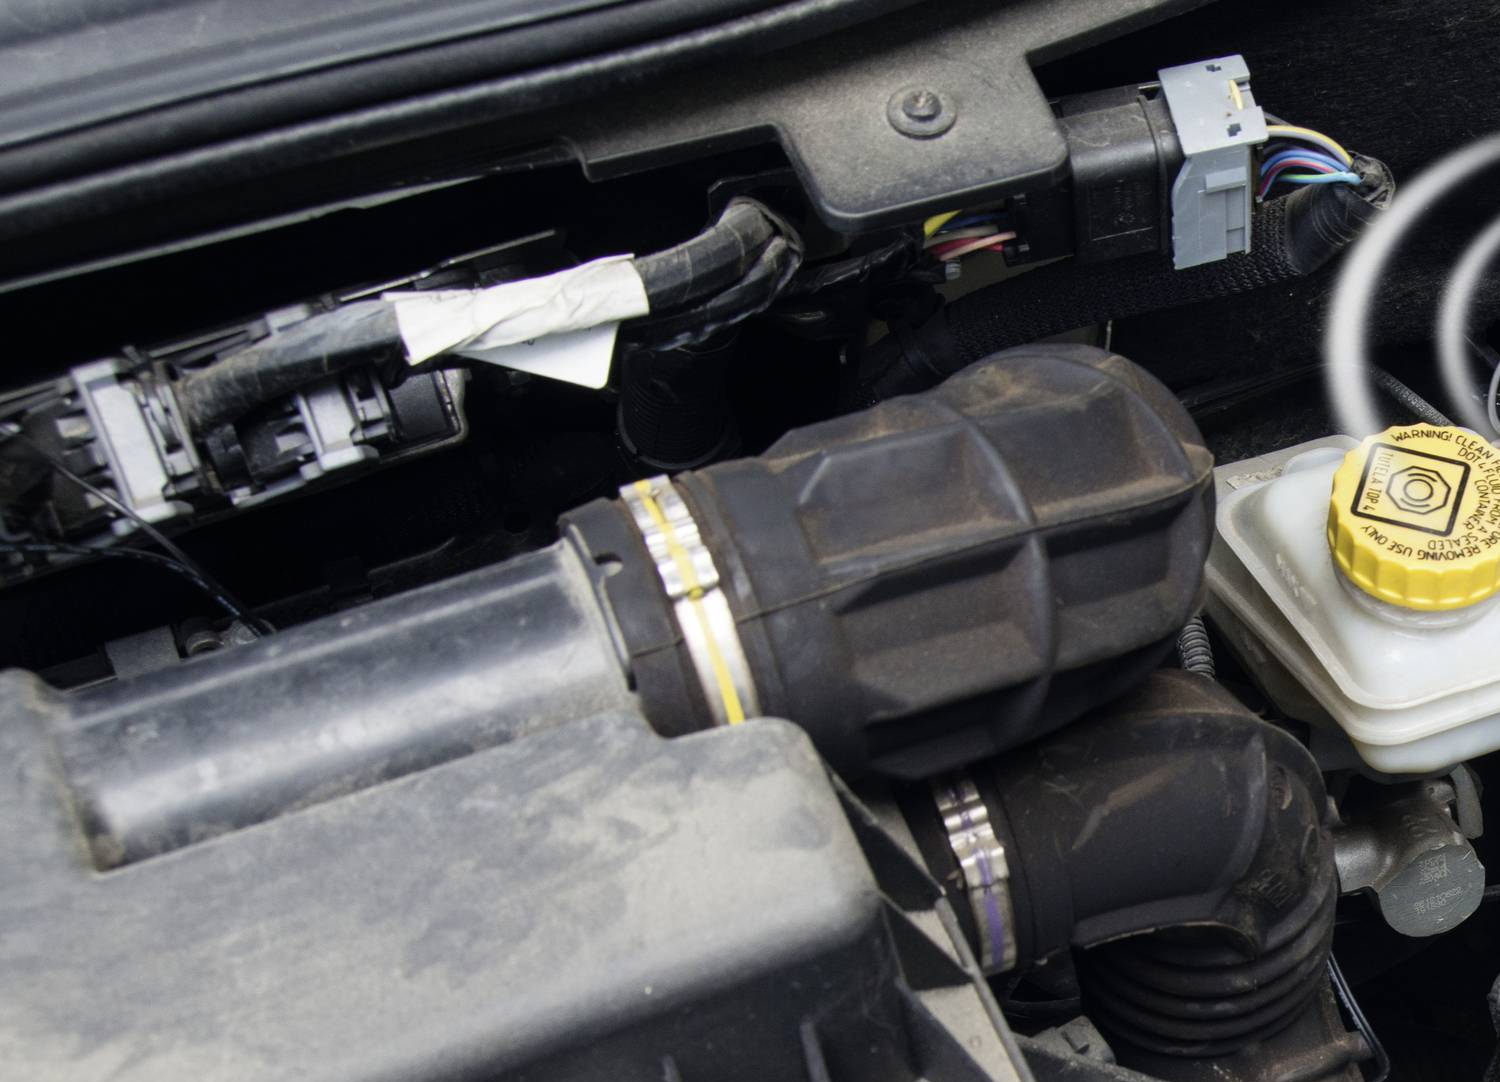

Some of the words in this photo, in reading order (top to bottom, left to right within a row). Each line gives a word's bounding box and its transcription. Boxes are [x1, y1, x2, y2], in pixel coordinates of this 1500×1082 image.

[1391, 429, 1452, 442] WARNING!
[1455, 435, 1494, 459] CLEAN
[1457, 447, 1482, 464] DOT
[1371, 452, 1394, 484] TUTELA
[1365, 488, 1382, 504] TOP
[1462, 479, 1491, 531] CONTAINER
[1360, 524, 1389, 545] ONLY
[1427, 531, 1479, 551] SEALED
[1386, 541, 1413, 557] USE
[1417, 544, 1482, 561] REMOVING
